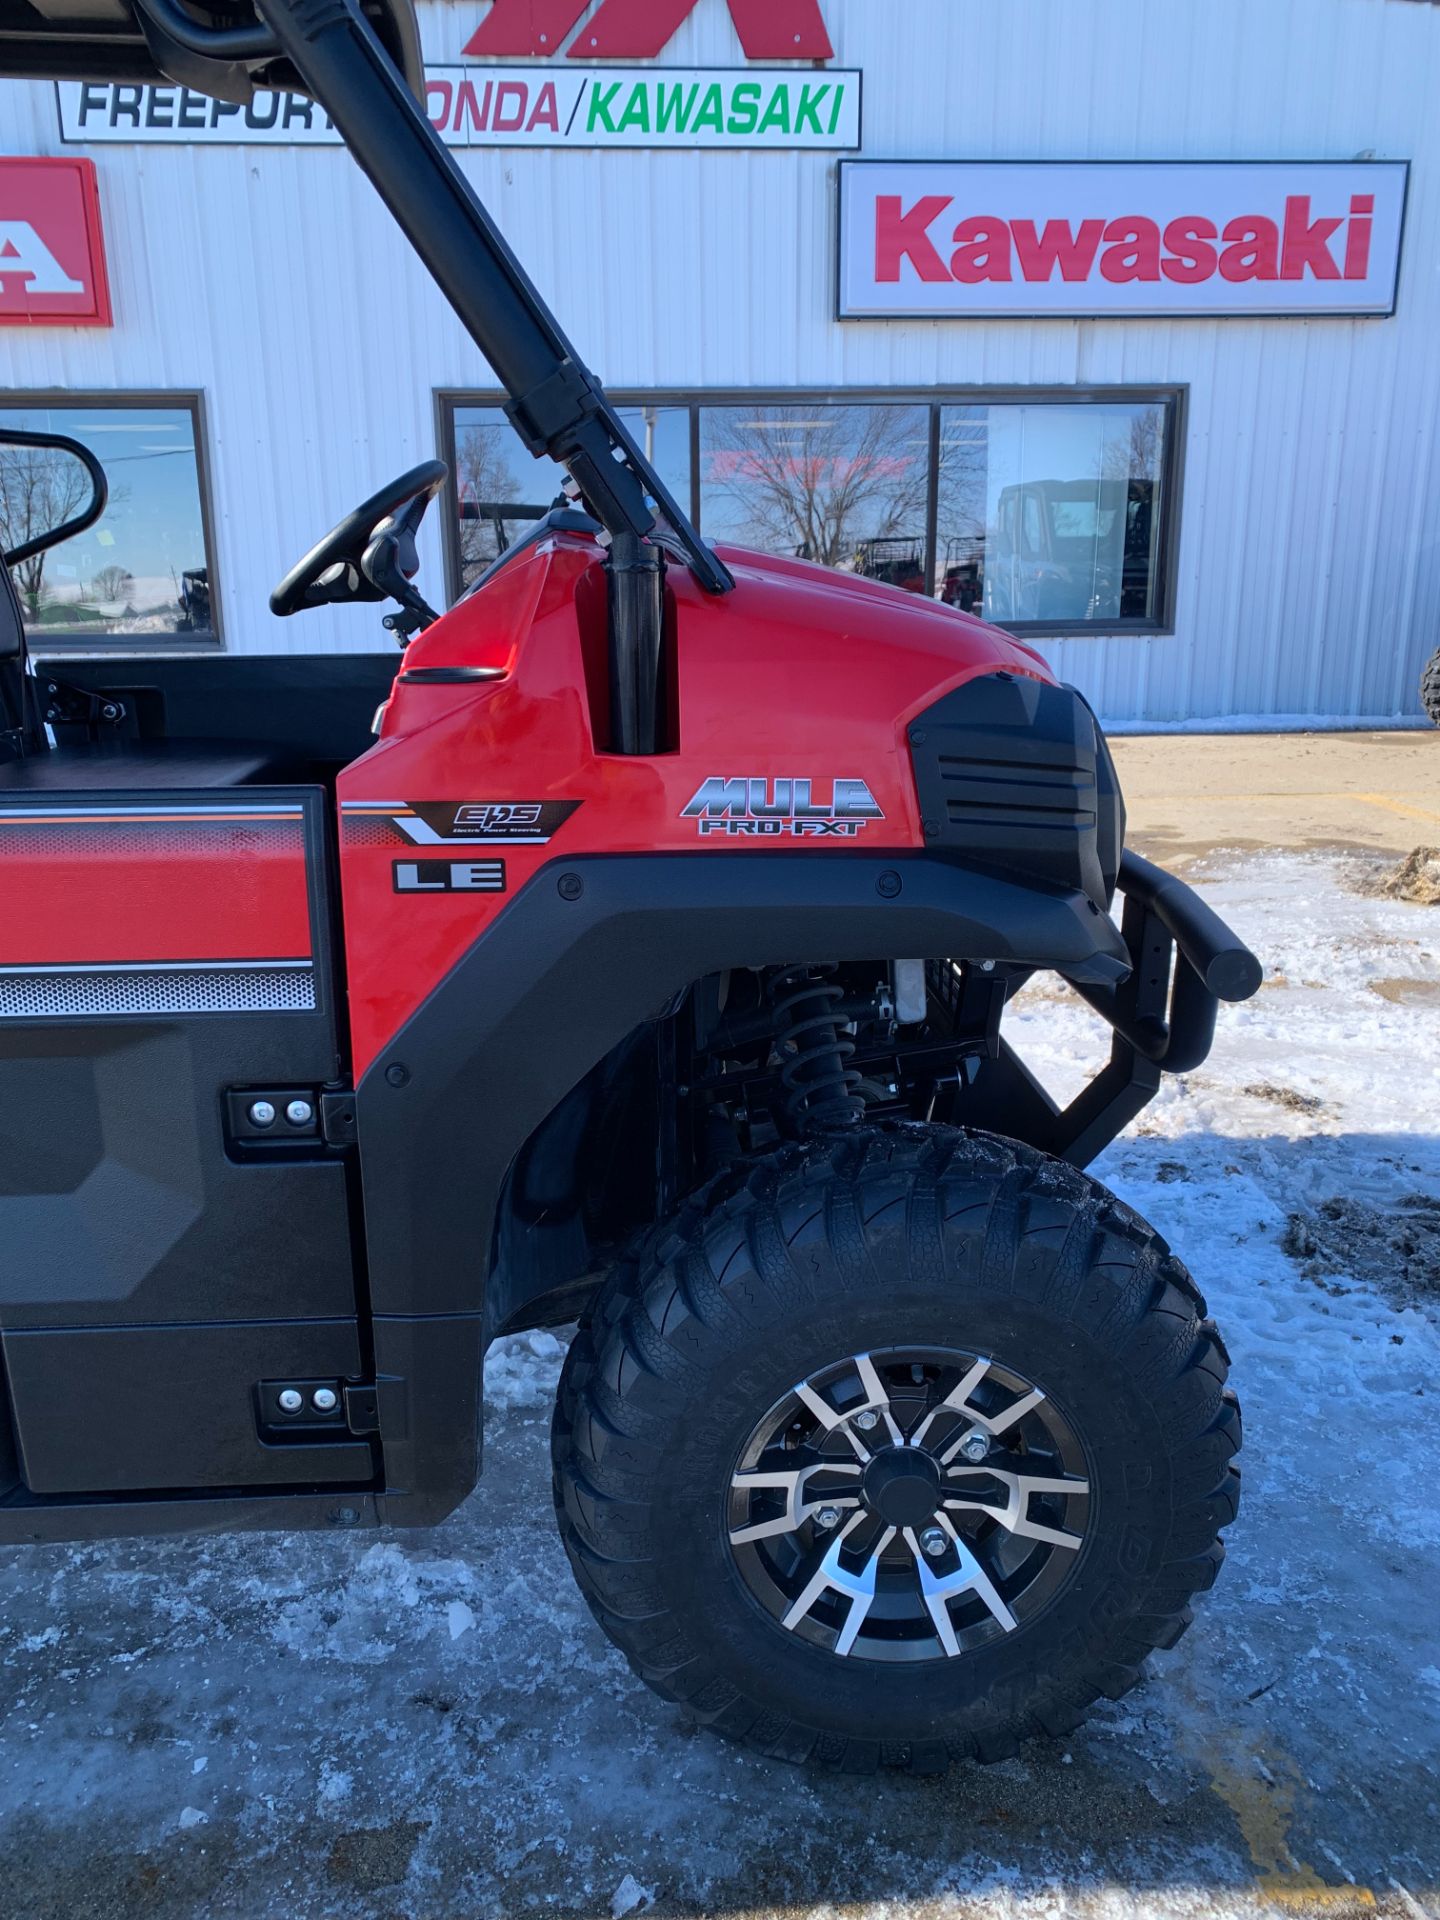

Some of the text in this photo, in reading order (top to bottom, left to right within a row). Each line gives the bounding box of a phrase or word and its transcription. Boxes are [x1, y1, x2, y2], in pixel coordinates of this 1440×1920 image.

[78, 83, 334, 130] FREEPOR
[874, 193, 1375, 284] Kawasaki
[679, 776, 885, 819] MULE
[698, 819, 867, 836] PRO-FXT
[395, 863, 503, 889] LE
